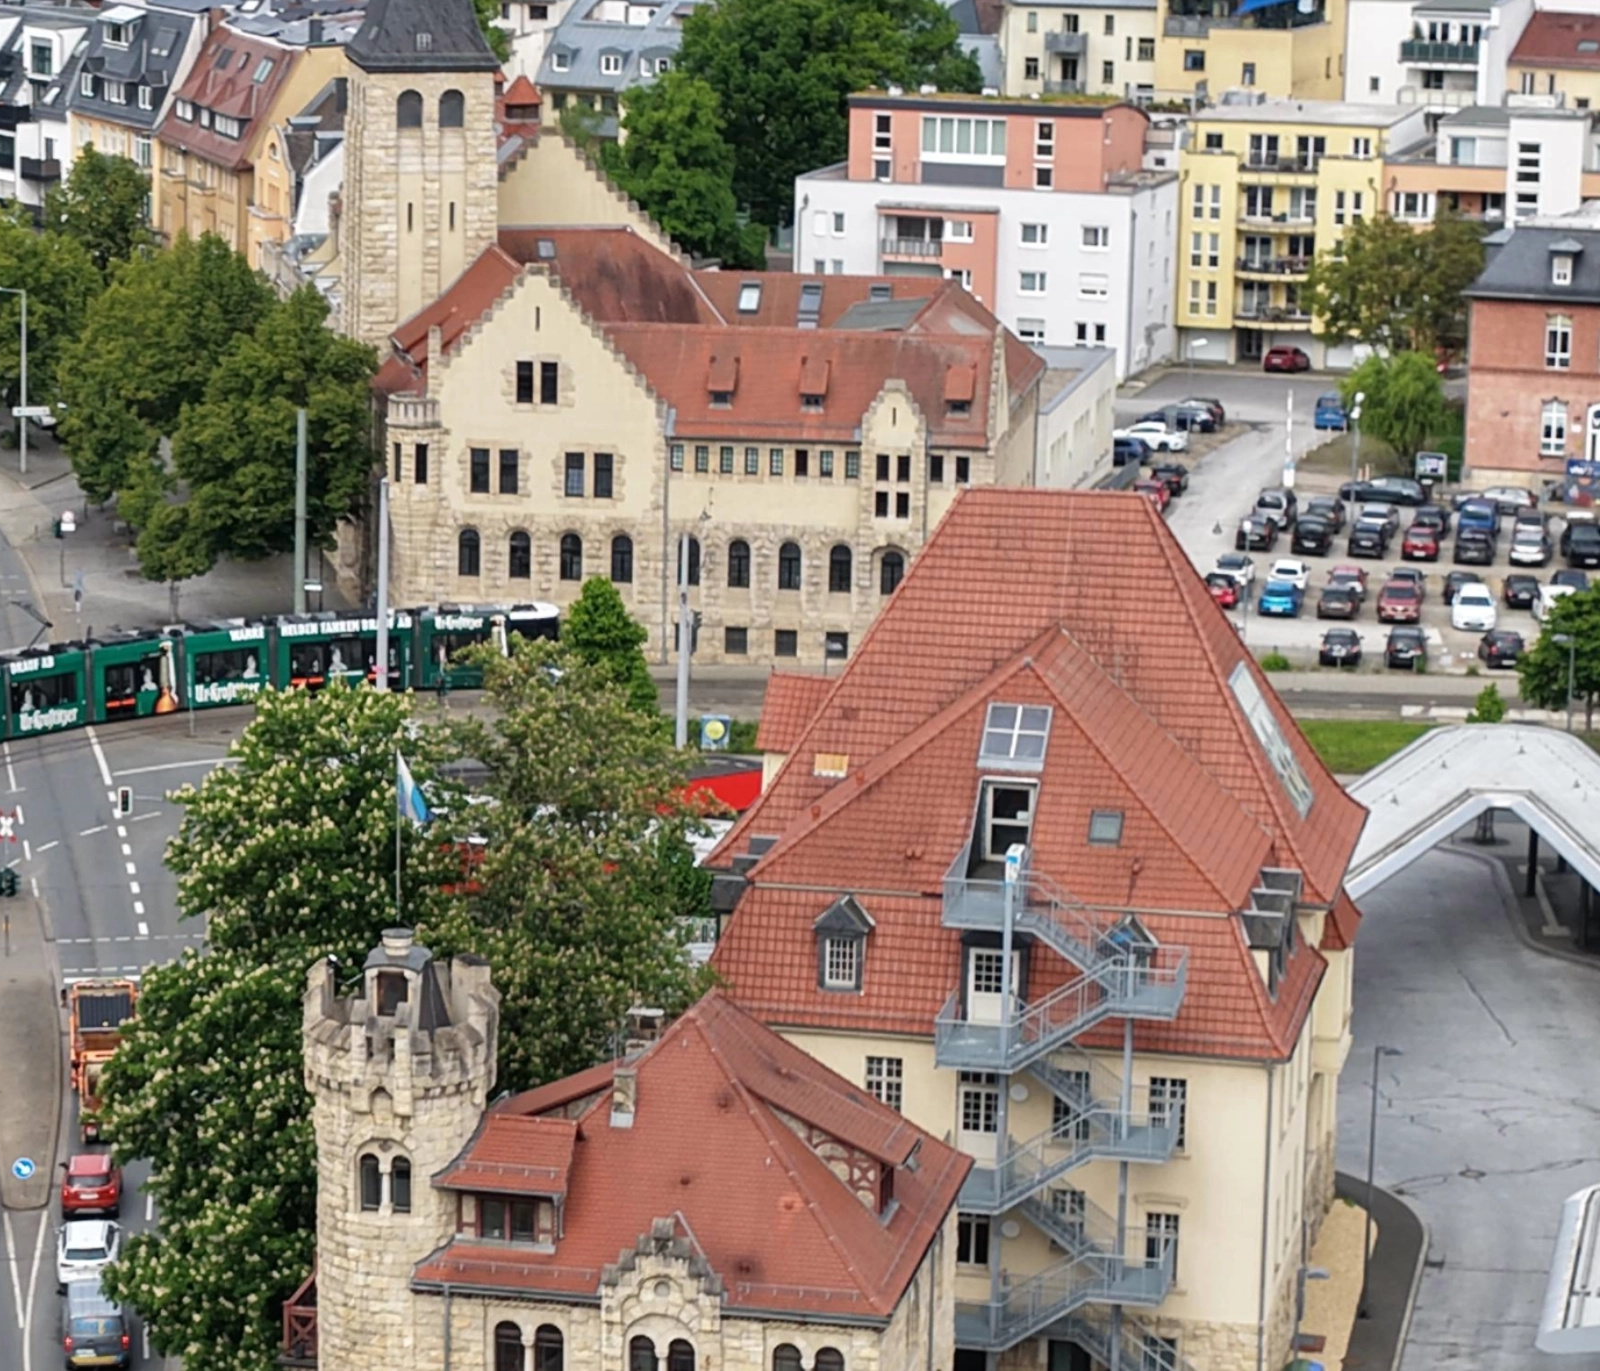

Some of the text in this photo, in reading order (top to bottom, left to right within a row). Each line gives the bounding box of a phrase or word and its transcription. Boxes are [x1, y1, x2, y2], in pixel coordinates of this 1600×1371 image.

[281, 622, 318, 637] HELDEN
[320, 619, 360, 634] FAHREN
[398, 616, 413, 629] AB
